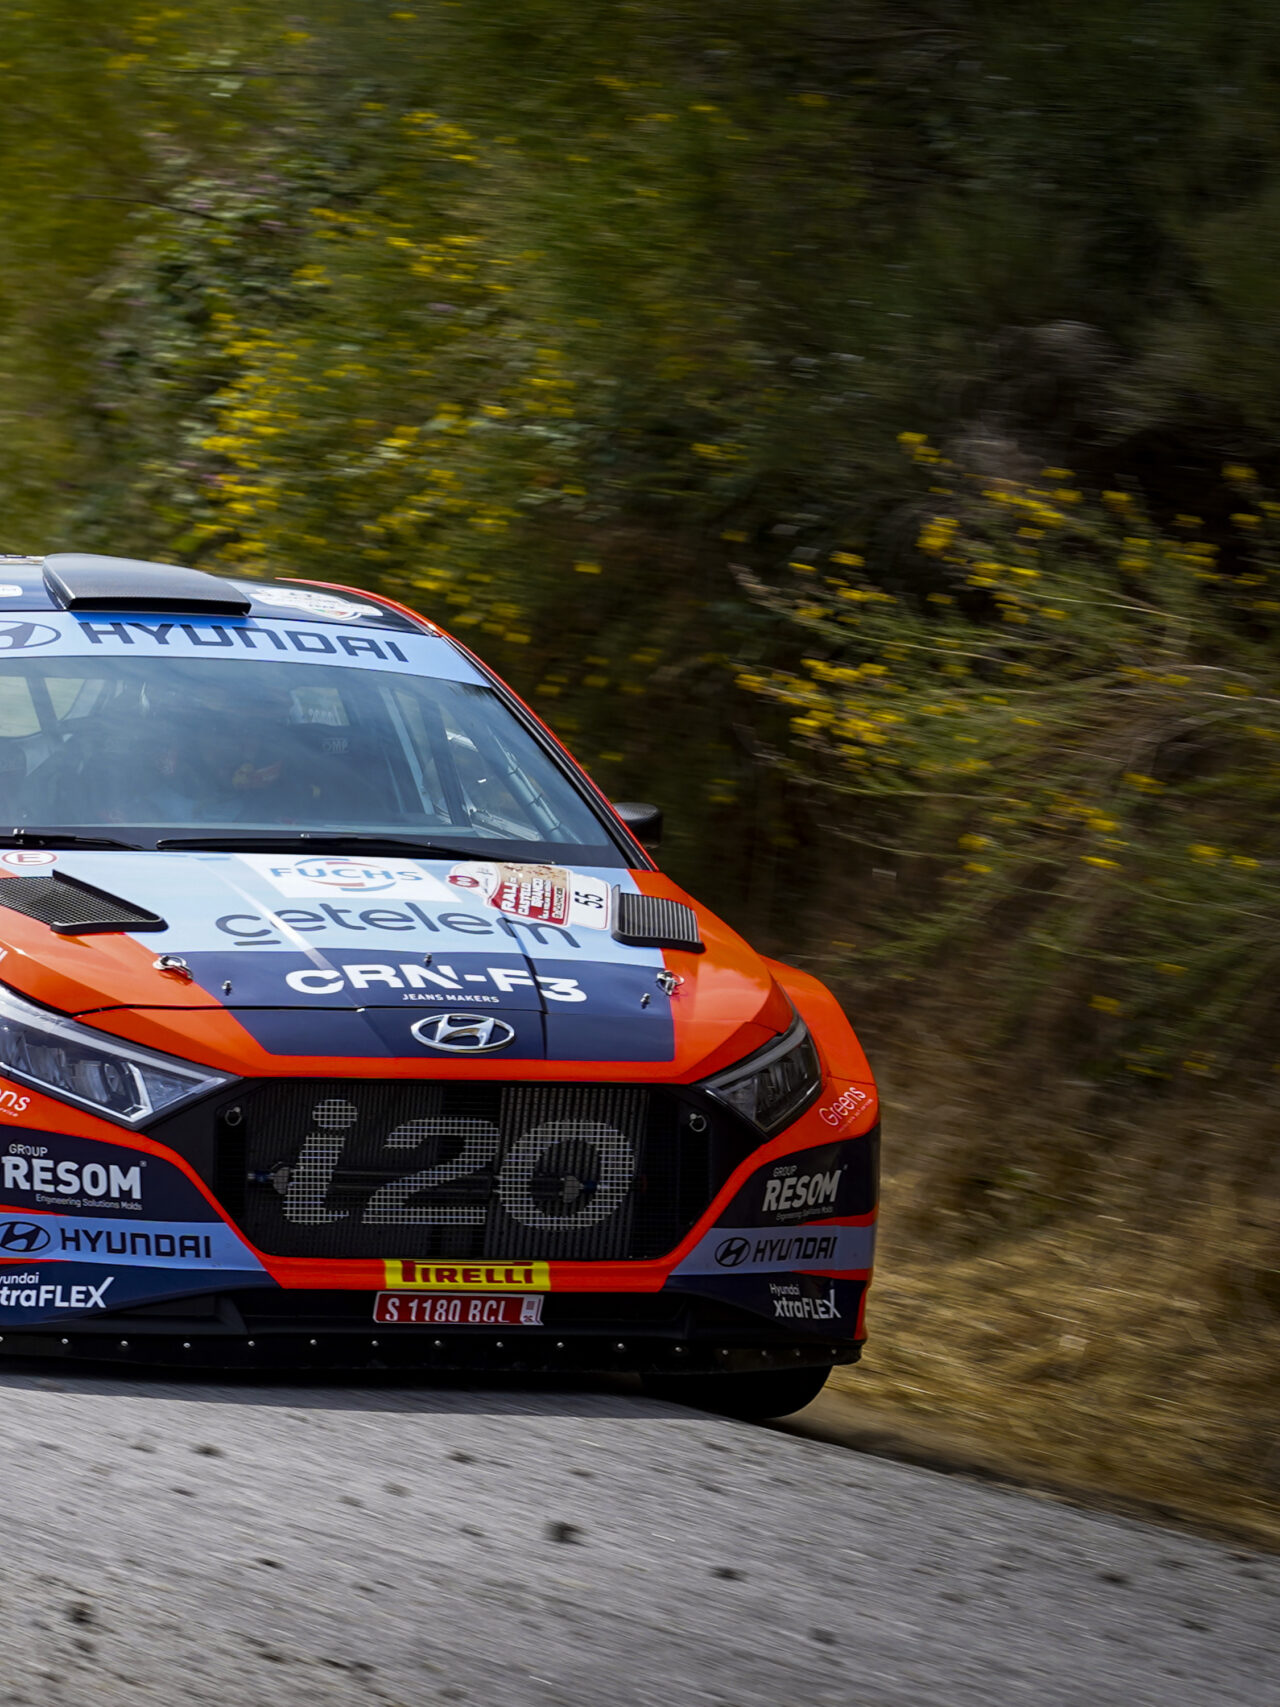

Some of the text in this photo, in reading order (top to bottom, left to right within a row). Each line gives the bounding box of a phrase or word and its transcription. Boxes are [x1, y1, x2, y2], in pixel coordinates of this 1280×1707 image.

[78, 621, 409, 663] HYUNDAI
[17, 853, 41, 863] E
[269, 866, 425, 885] FUCHS
[574, 891, 604, 910] 55
[215, 901, 582, 949] cetelem
[285, 963, 588, 1003] CRN-F3
[402, 993, 500, 1004] JEANS MAKERS
[818, 1086, 867, 1126] Greens
[8, 1143, 49, 1157] GROUP
[1, 1155, 143, 1200] RESOM
[282, 1099, 636, 1231] i20
[35, 1193, 81, 1208] Engineering
[82, 1198, 120, 1209] Solutions
[762, 1169, 843, 1212] RESOM
[60, 1227, 212, 1259] HYUNDAI
[752, 1236, 838, 1263] HYUNDAI
[400, 1259, 535, 1285] PIRELLI
[770, 1283, 800, 1297] Hyundai
[384, 1298, 400, 1321] S
[408, 1298, 462, 1322] 1180
[468, 1299, 510, 1323] BCL
[773, 1289, 842, 1320] xtraFLEX
